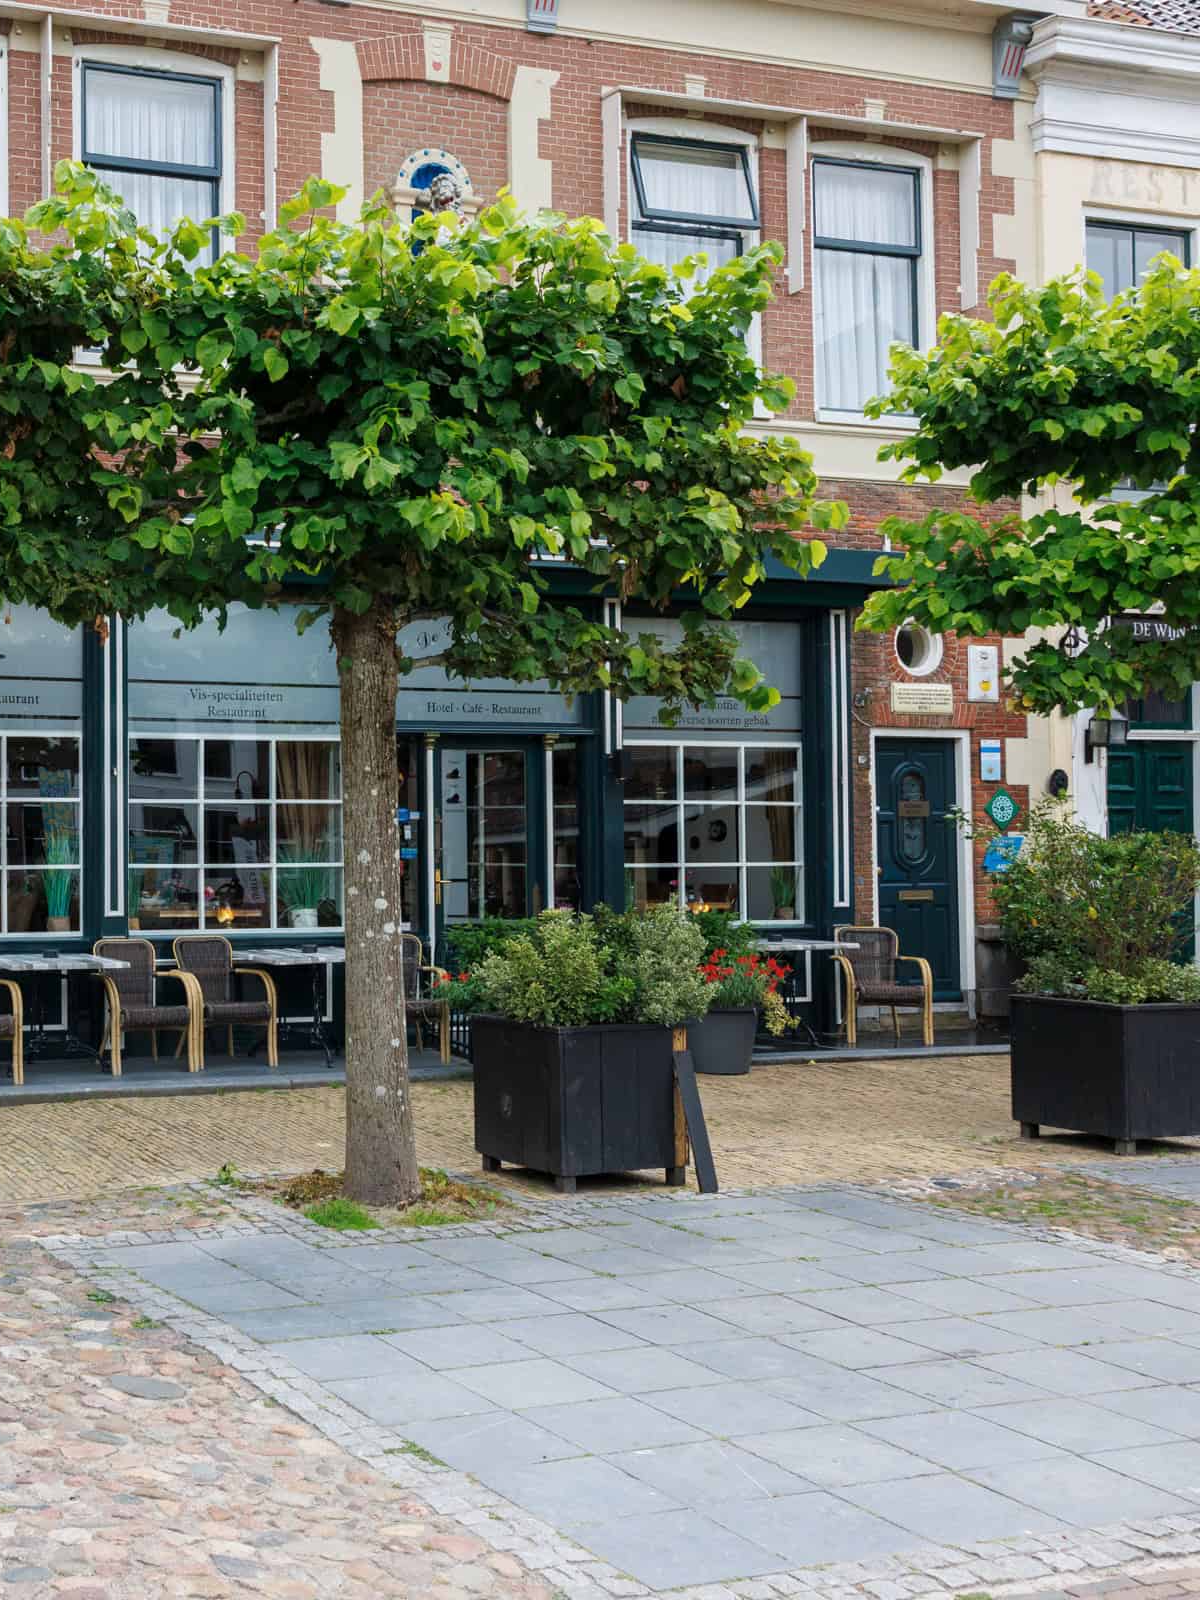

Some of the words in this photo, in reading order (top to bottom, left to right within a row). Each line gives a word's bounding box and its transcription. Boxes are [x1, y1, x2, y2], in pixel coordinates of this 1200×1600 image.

[1133, 621, 1151, 637] DE
[417, 631, 439, 649] De
[190, 687, 283, 703] Vis-specialiteiten
[207, 705, 266, 718] Restaurant
[426, 701, 453, 714] Hotel
[462, 702, 484, 714] Café
[492, 703, 542, 715] Restaurant
